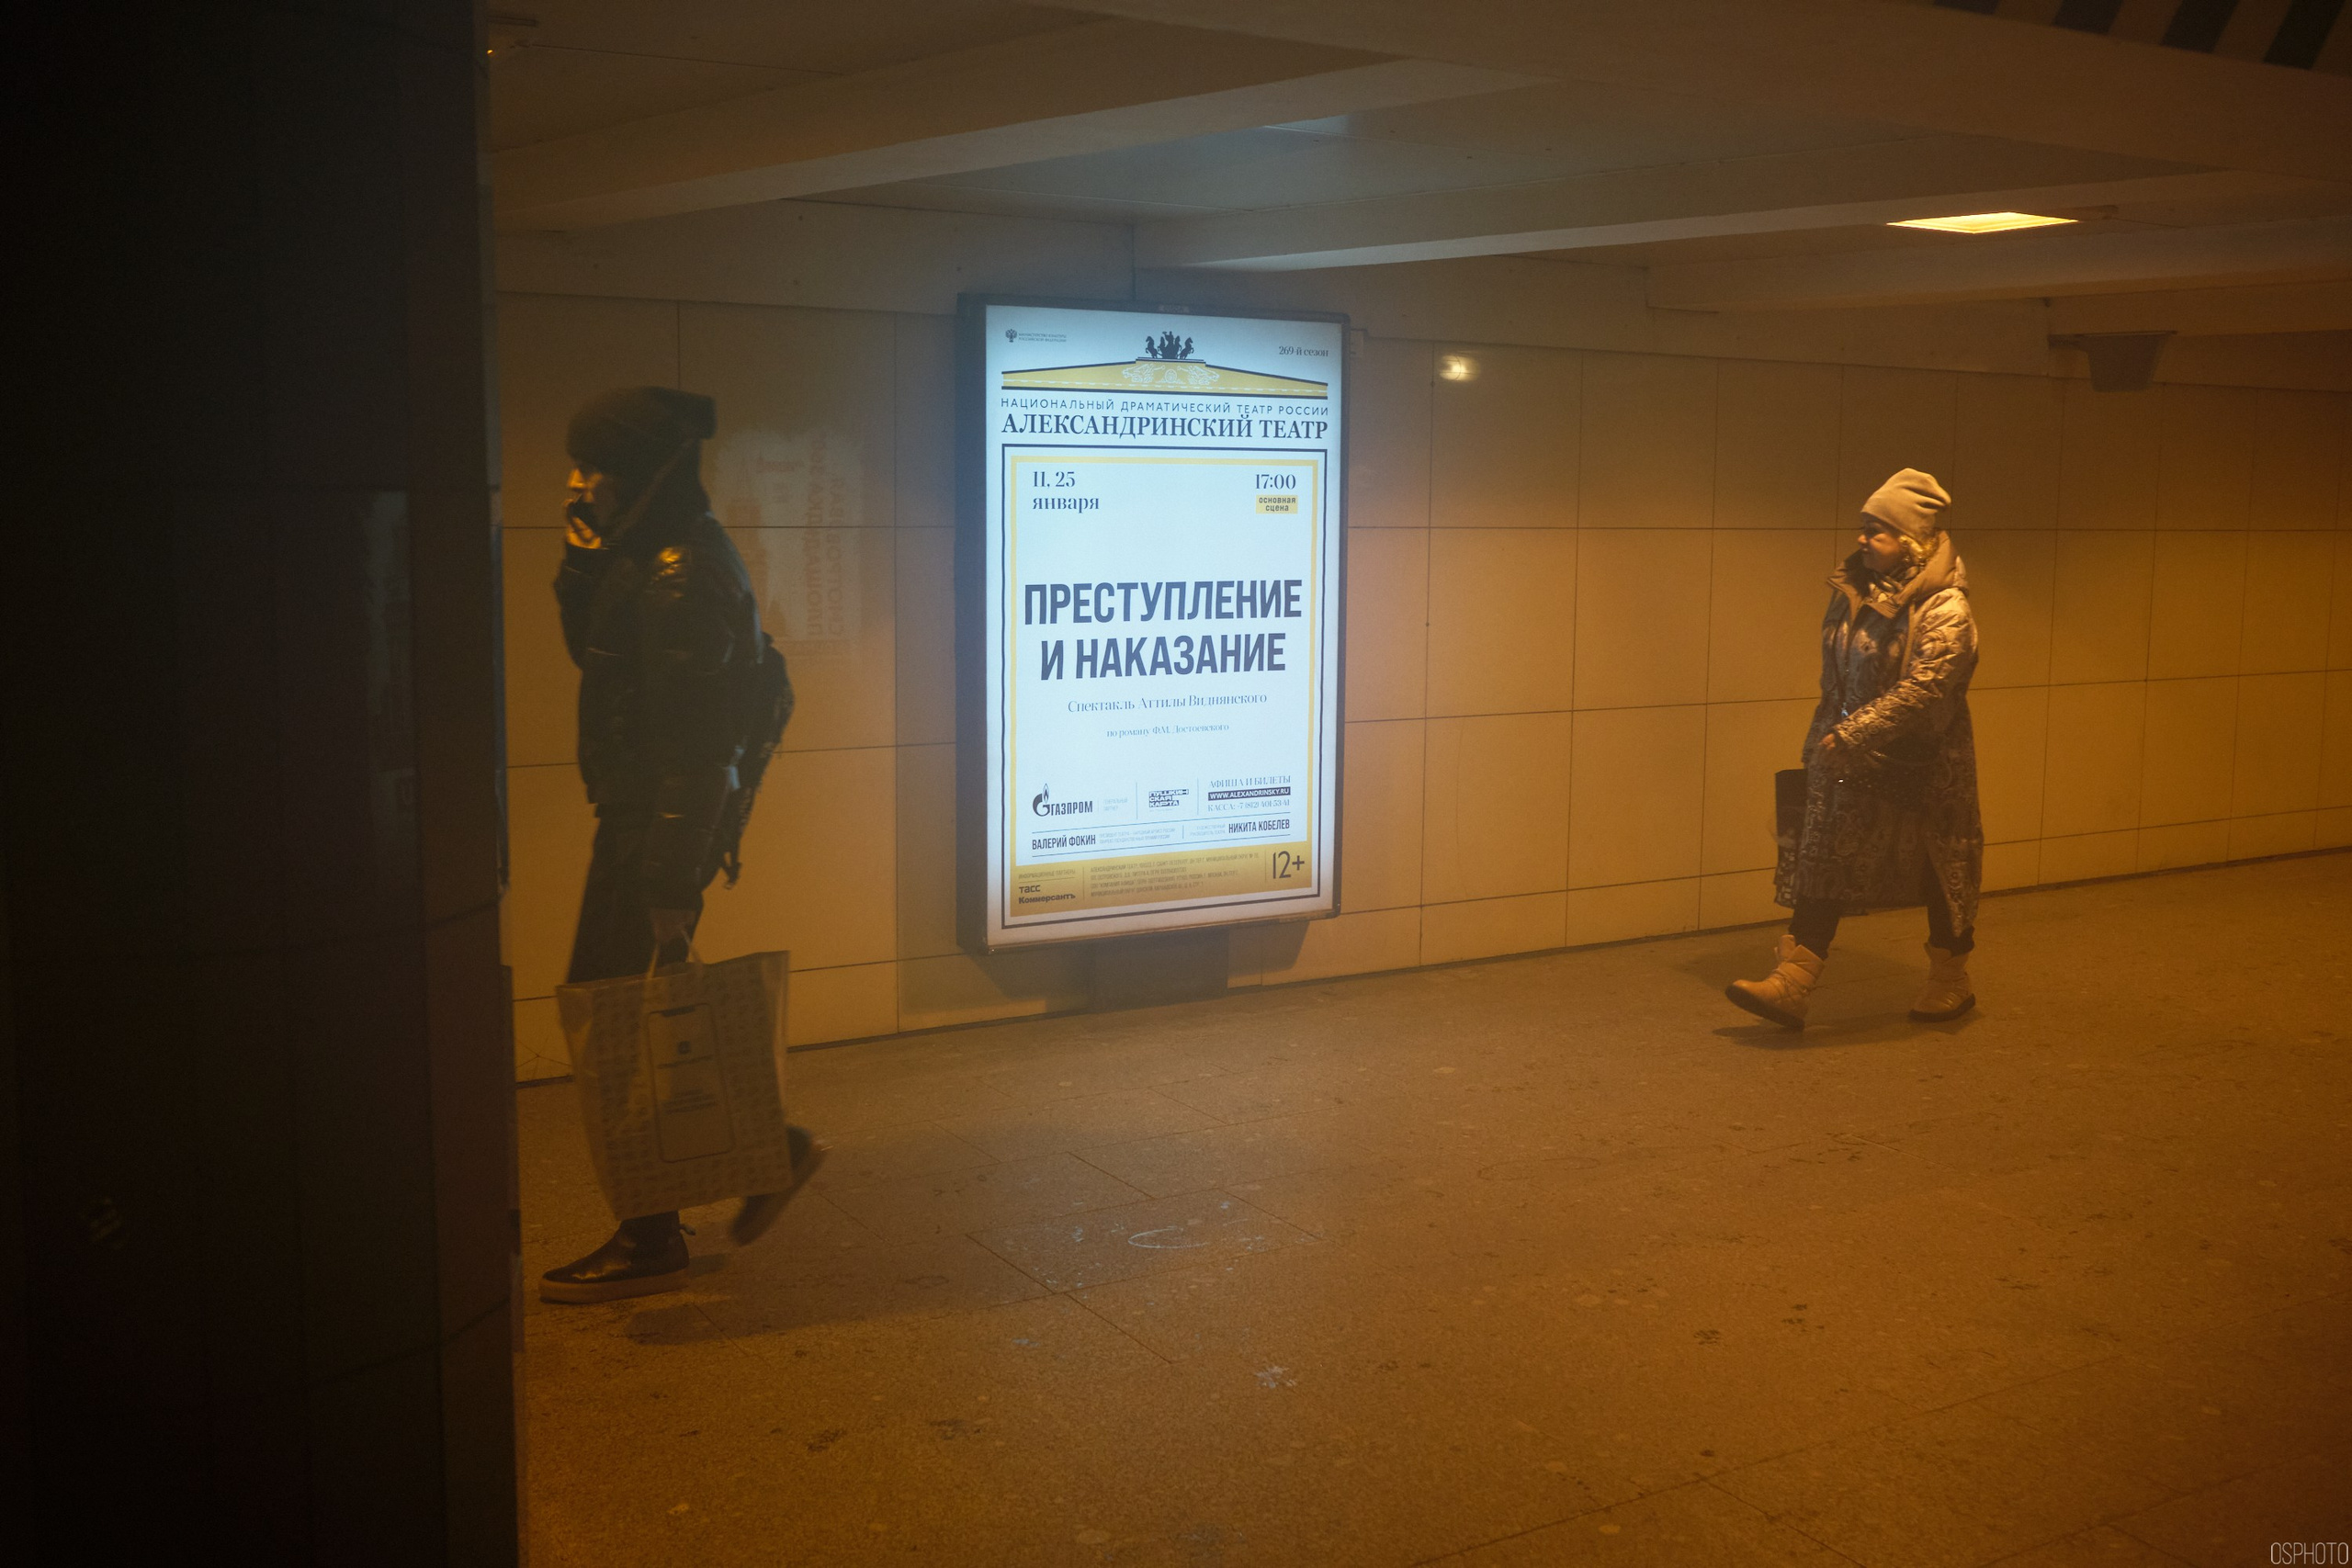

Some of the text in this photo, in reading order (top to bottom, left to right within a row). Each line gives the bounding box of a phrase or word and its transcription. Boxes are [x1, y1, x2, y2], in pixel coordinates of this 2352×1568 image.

[1304, 349, 1329, 357] сезон
[1001, 398, 1329, 416] НАЦИОНАЛЬНЫЙ ДРАМАТИЧЕСКИЙ ТЕАТР РОССИИ
[1001, 413, 1329, 439] АЛЕКСАНДРИНСКИЙ ТЕАТР
[1033, 471, 1076, 489] 11, 25
[1255, 474, 1296, 490] 17:00
[1033, 498, 1100, 514] января
[1024, 579, 1303, 626] ПРЕСТУПЛЕНИЕ
[1040, 632, 1286, 681] И НАКАЗАНИЕ
[1068, 694, 1267, 713] Спектакль Аттилы Виднянского
[1106, 730, 1118, 739] по
[1118, 728, 1150, 739] роману
[1209, 775, 1292, 788] АФИША И БИЛЕТЫ
[1148, 788, 1189, 796] ПУШКИН
[1209, 787, 1290, 800] WWW.ALEXANDRINSKY.RU
[1050, 800, 1093, 817] ГАЗПРОМ
[1228, 821, 1257, 834] НИКИТА
[1258, 818, 1290, 831] КОБЕЛЕВ
[1032, 835, 1068, 851] ВАЛЕРИЙ
[1069, 834, 1096, 847] ФОКИН
[1272, 850, 1306, 879] 12+
[1018, 893, 1076, 904] Коммерсантъ
